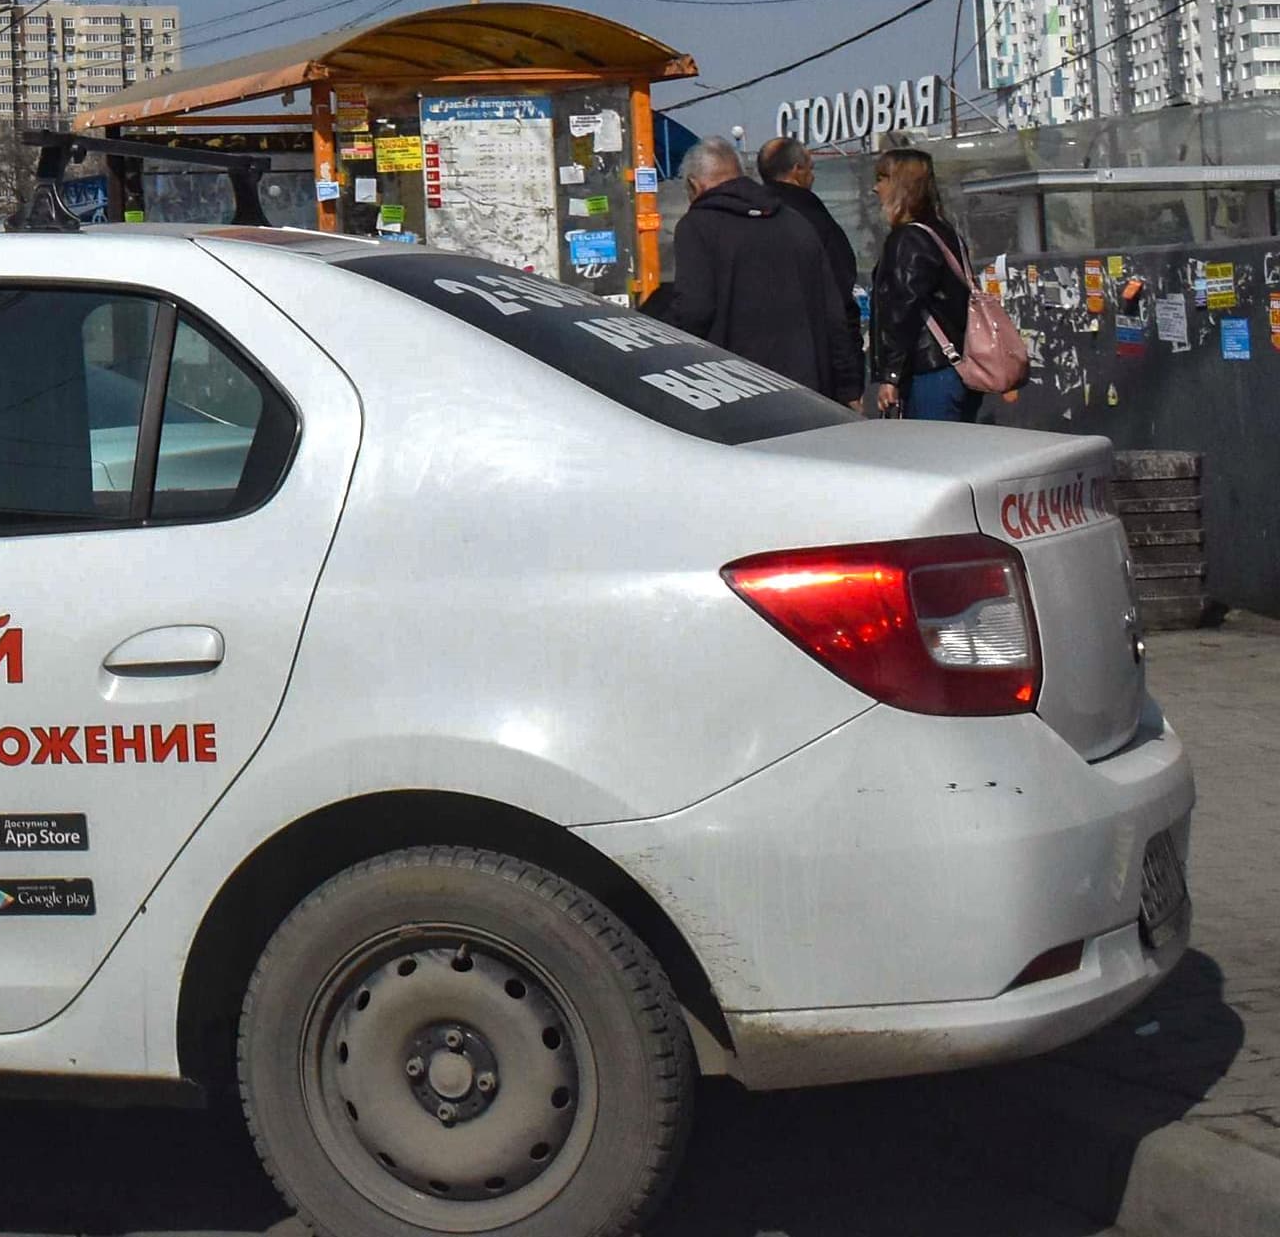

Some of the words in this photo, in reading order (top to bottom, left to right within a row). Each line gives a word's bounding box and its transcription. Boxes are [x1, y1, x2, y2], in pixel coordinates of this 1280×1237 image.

[776, 74, 940, 145] СТОЛОВАЯ
[1001, 472, 1088, 539] СКАЧАЙ
[4, 820, 49, 829] Доступно
[5, 829, 37, 848] App
[40, 829, 80, 844] Store
[18, 891, 62, 909] Google
[66, 892, 90, 908] play
